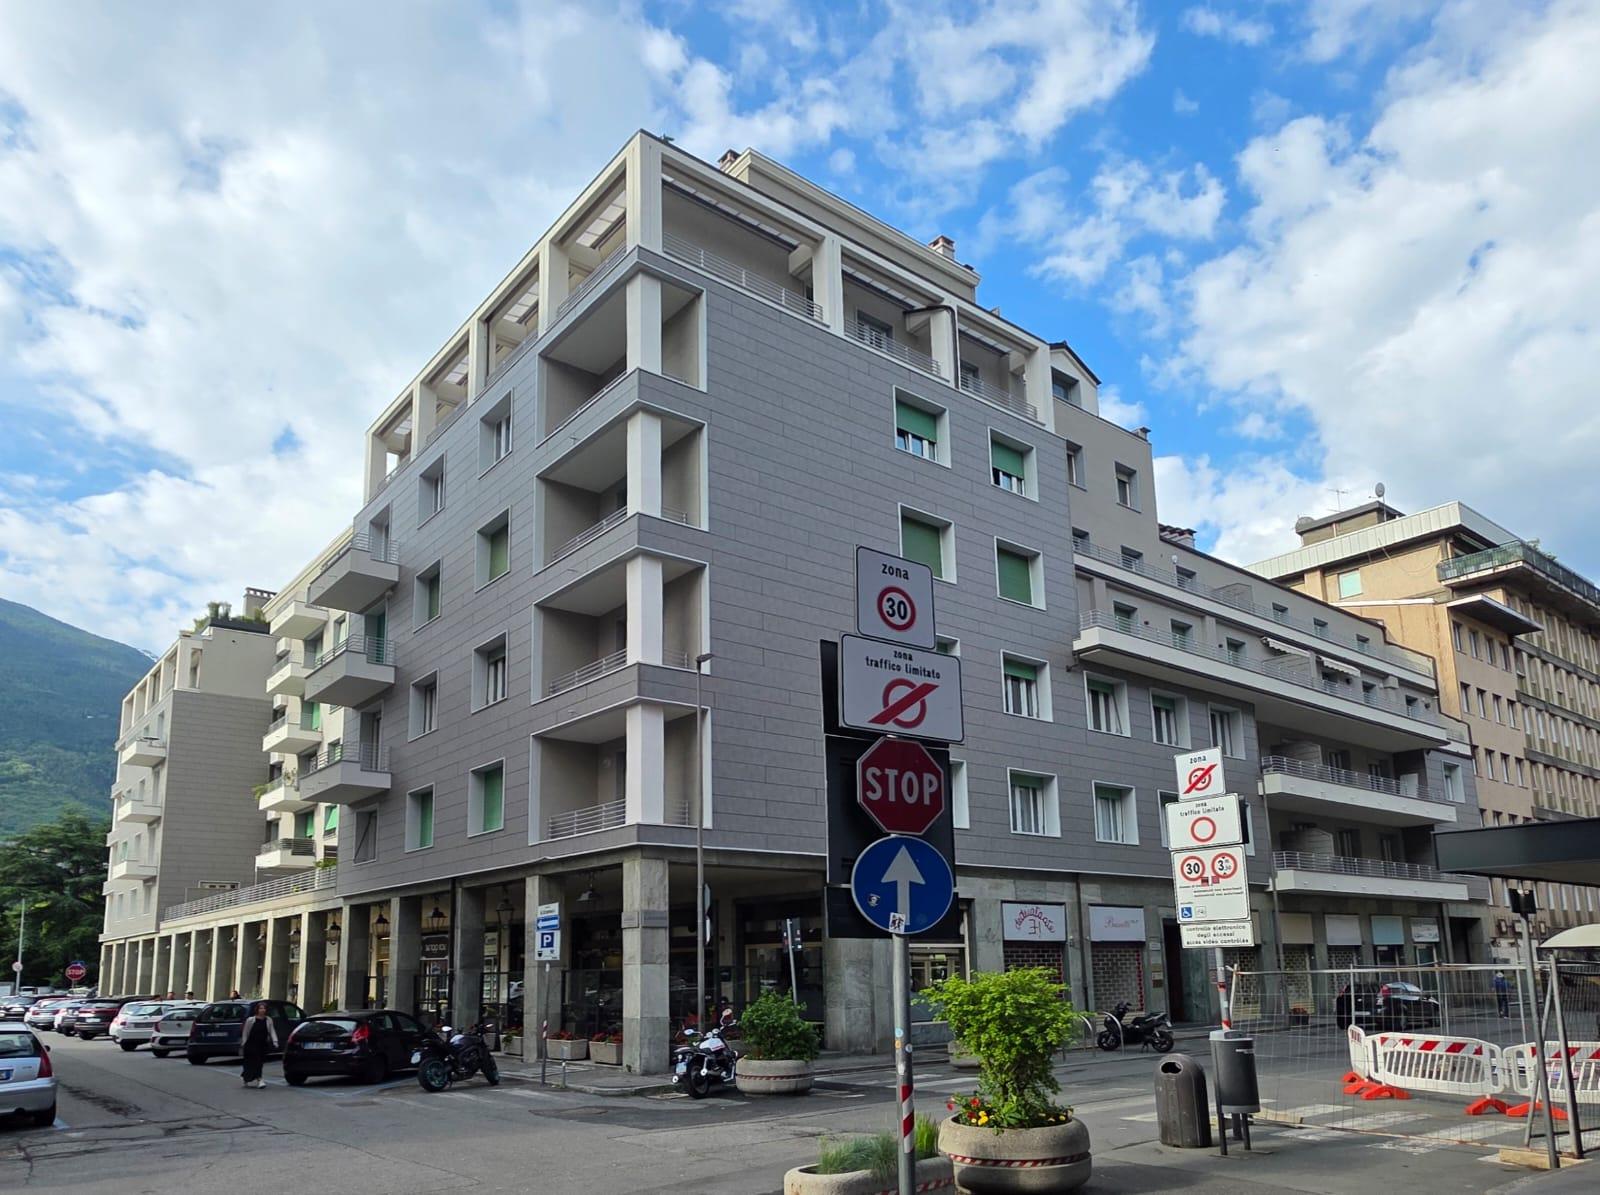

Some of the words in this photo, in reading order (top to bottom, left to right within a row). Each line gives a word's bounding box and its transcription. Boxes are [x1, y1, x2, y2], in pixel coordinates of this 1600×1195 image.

[881, 562, 909, 581] zona
[885, 596, 909, 621] 30
[893, 650, 913, 661] zona
[865, 656, 901, 673] traffico
[905, 664, 940, 680] limitato
[1190, 755, 1207, 764] zona
[865, 766, 938, 806] STOP
[1186, 863, 1200, 875] 30
[543, 935, 552, 947] P
